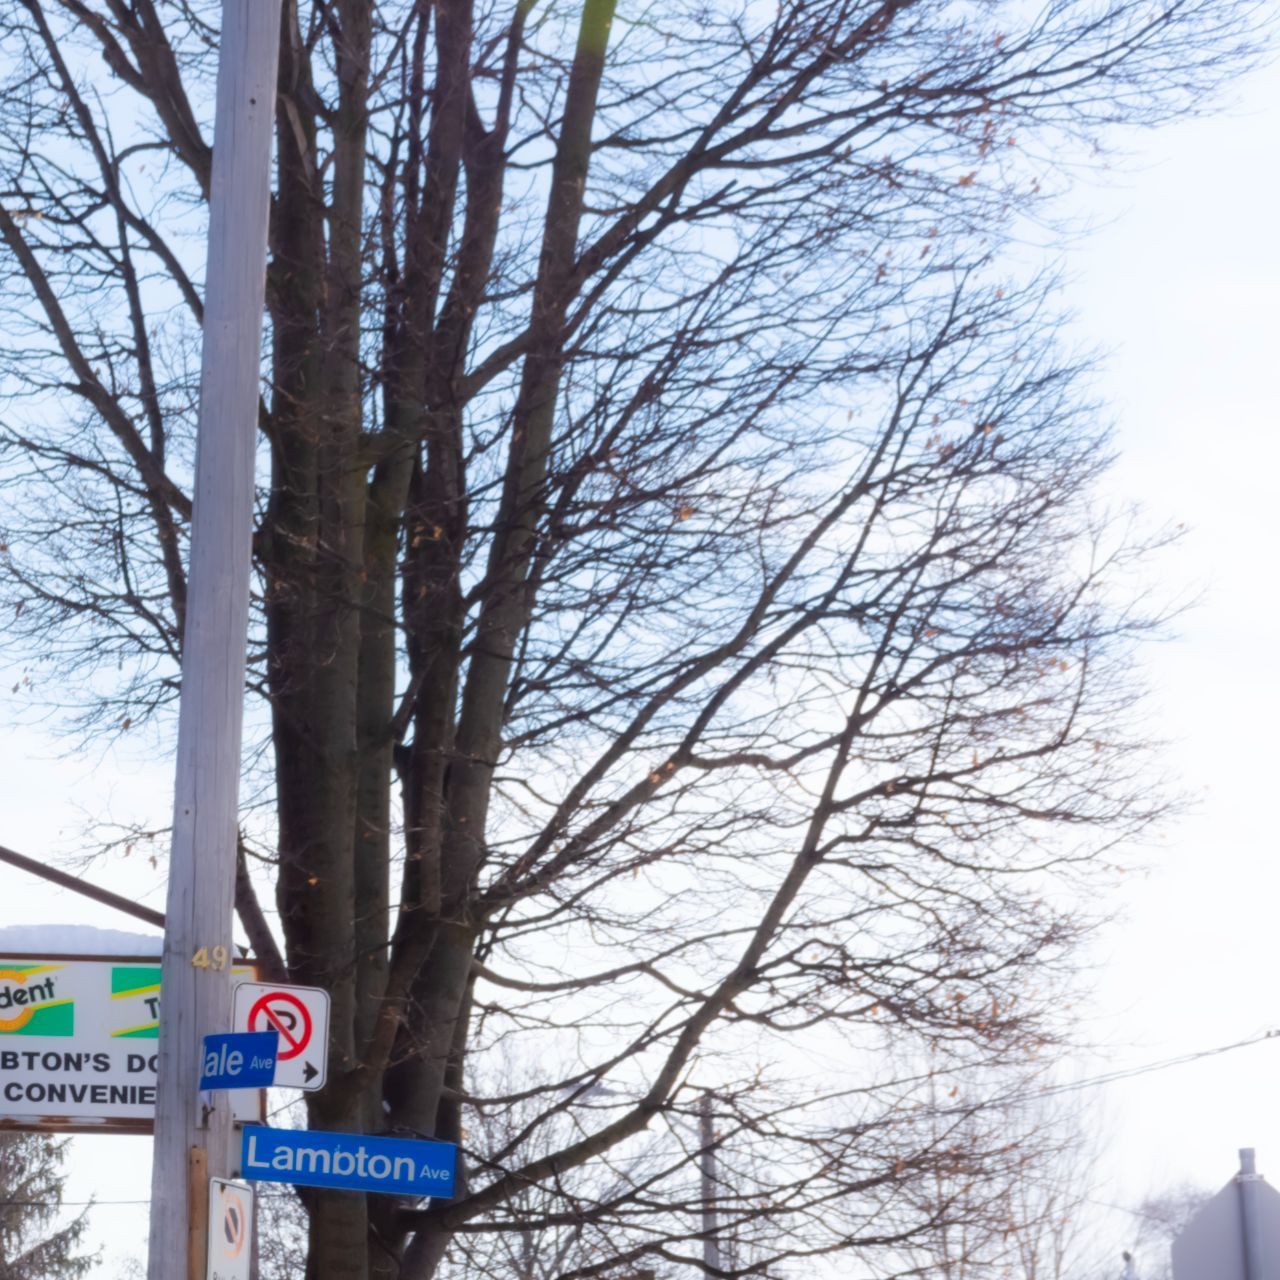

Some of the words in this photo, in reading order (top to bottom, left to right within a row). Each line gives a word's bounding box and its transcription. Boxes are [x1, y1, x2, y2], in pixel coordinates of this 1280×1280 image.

[191, 945, 228, 972] 49
[200, 1044, 244, 1078] ale
[249, 1055, 273, 1070] Ave
[247, 1135, 416, 1182] Lambton
[419, 1164, 451, 1181] Ave
